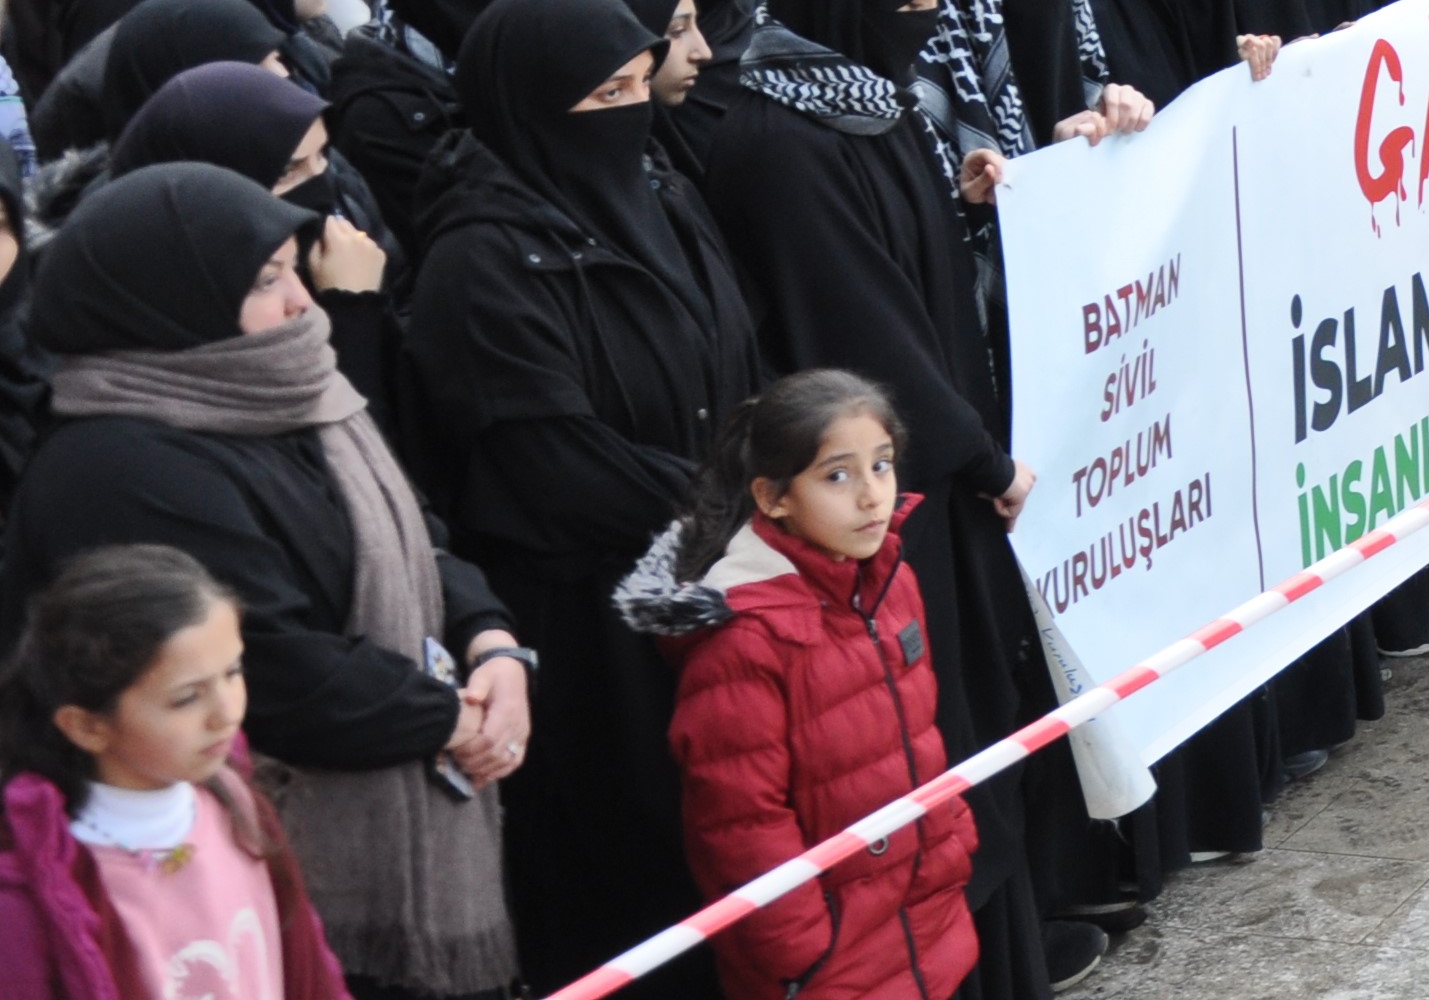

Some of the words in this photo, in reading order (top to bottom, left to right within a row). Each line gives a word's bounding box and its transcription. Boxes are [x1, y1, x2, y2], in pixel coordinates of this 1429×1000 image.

[1081, 252, 1181, 355] BATMAN
[1100, 338, 1157, 423] SİVİL
[1072, 413, 1173, 518] TOPLUM
[1036, 472, 1213, 619] KURULUŞLARI
